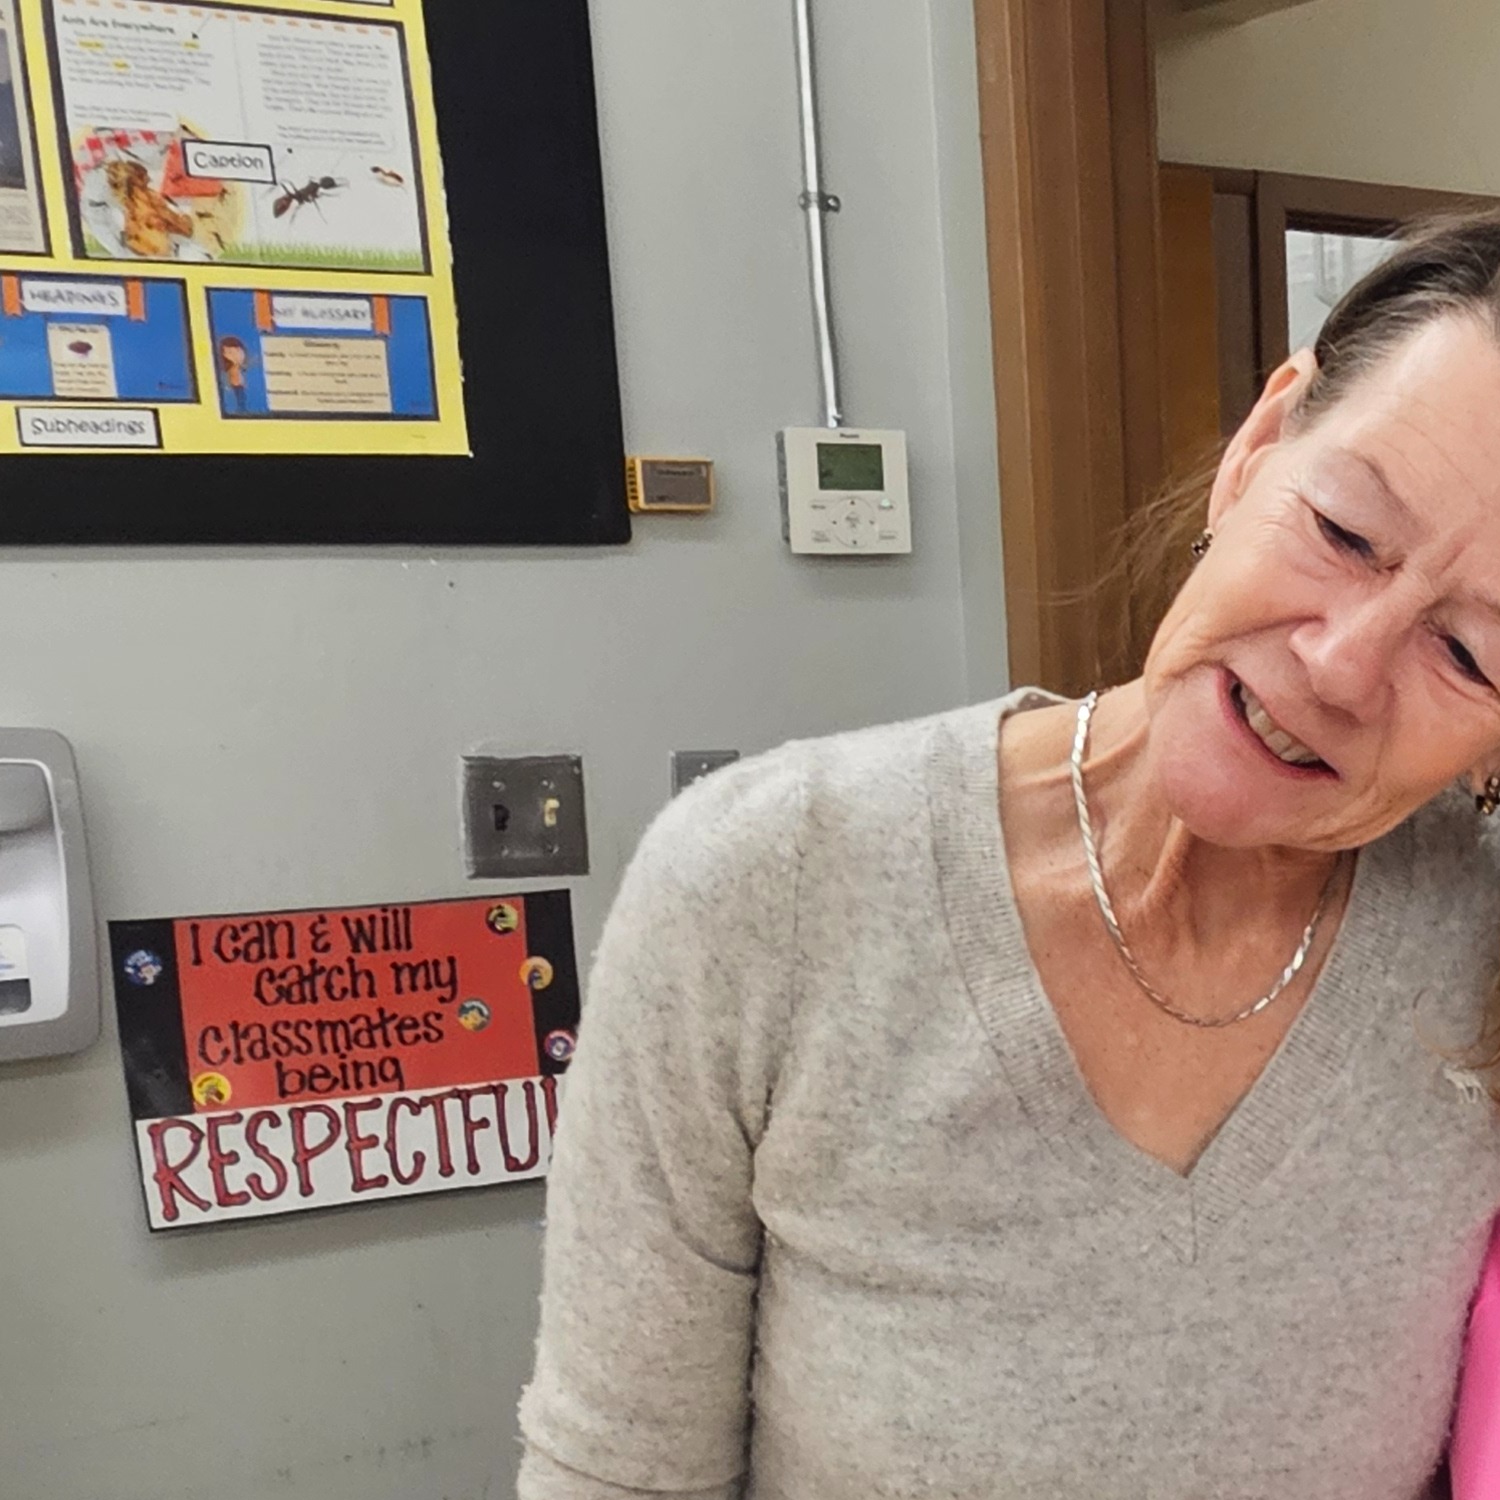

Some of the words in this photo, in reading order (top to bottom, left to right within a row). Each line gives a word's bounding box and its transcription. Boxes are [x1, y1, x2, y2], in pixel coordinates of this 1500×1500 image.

[193, 151, 264, 169] Caption
[31, 417, 146, 436] Subheadings
[189, 923, 203, 967] I
[213, 917, 296, 964] can
[341, 908, 414, 954] will
[253, 956, 378, 1007] catch
[390, 954, 459, 1004] my
[199, 1008, 445, 1067] classmates
[275, 1055, 405, 1099] being
